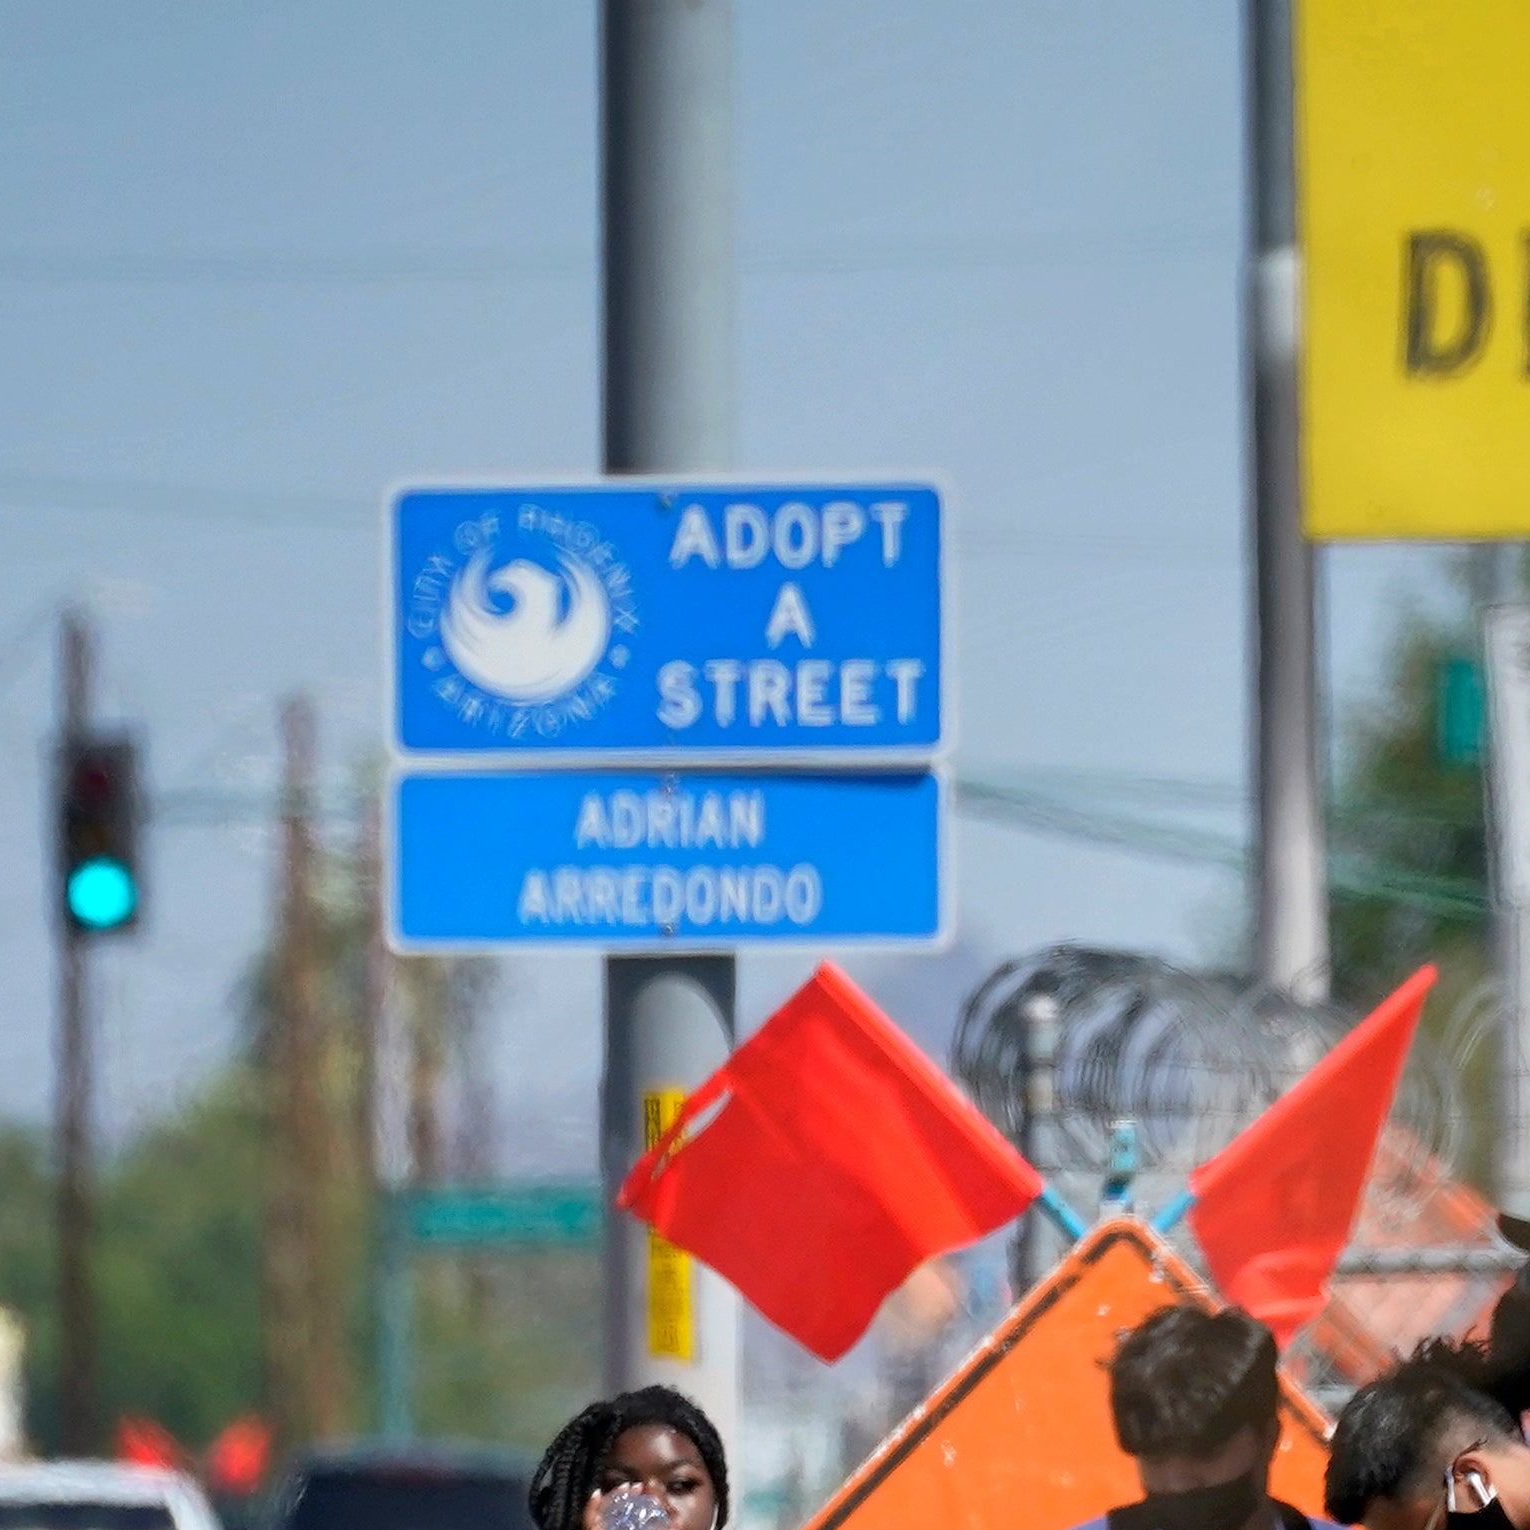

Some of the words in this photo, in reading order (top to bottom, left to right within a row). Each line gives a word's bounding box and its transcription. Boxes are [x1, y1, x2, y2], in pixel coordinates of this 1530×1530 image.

[670, 501, 908, 569] ADOPT
[765, 582, 816, 650] A
[656, 658, 925, 729] STREET
[575, 791, 765, 850] ADRIAN
[517, 864, 823, 925] ARREDONDO
